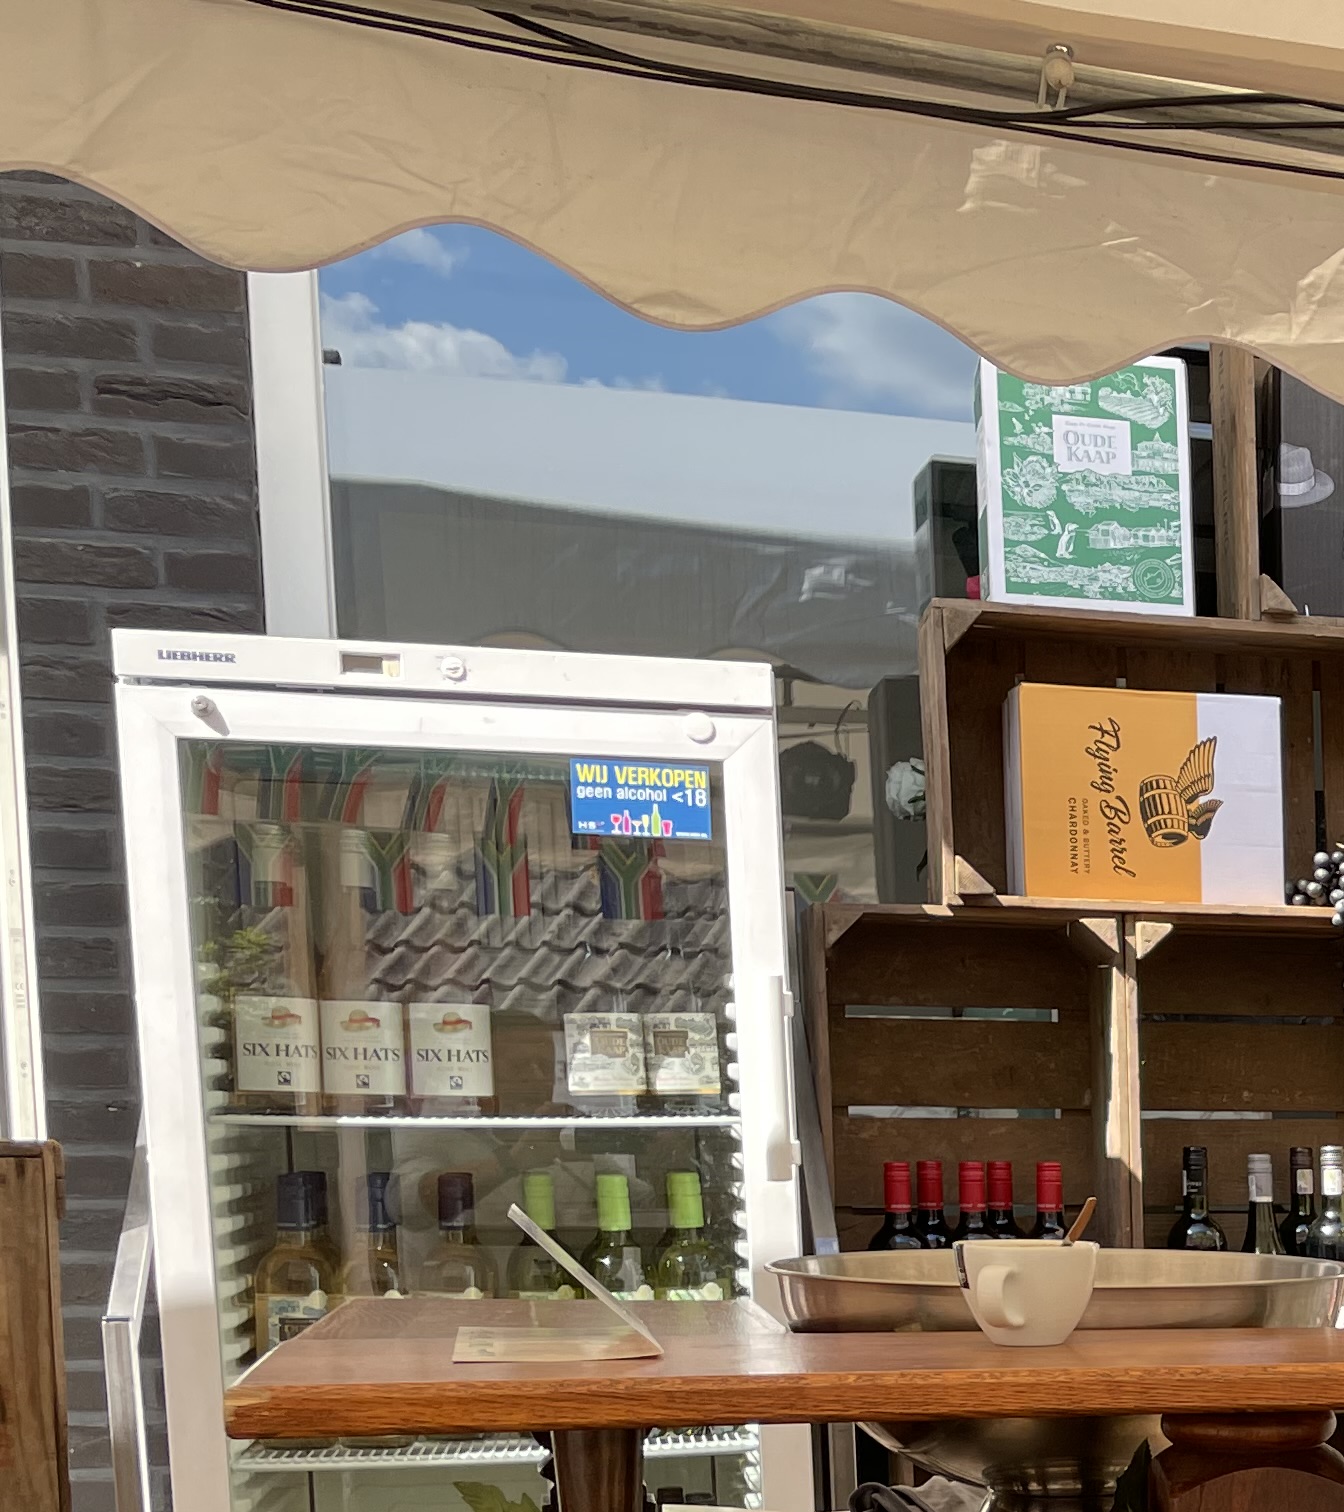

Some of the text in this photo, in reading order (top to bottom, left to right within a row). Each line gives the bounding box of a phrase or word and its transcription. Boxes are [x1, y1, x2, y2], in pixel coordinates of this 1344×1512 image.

[1063, 430, 1118, 449] OUDE
[1066, 446, 1117, 465] KAAP
[157, 649, 237, 664] LIEBHERR
[575, 762, 707, 789] WIJ VERKOPEN
[576, 785, 707, 807] geen alcohol <18
[1085, 717, 1136, 879] Flying Barrel
[1068, 797, 1079, 875] CHARDONNAY
[242, 1043, 318, 1059] SIX HATS
[325, 1046, 400, 1062] SIX HATS
[416, 1048, 489, 1064] SIX HATS
